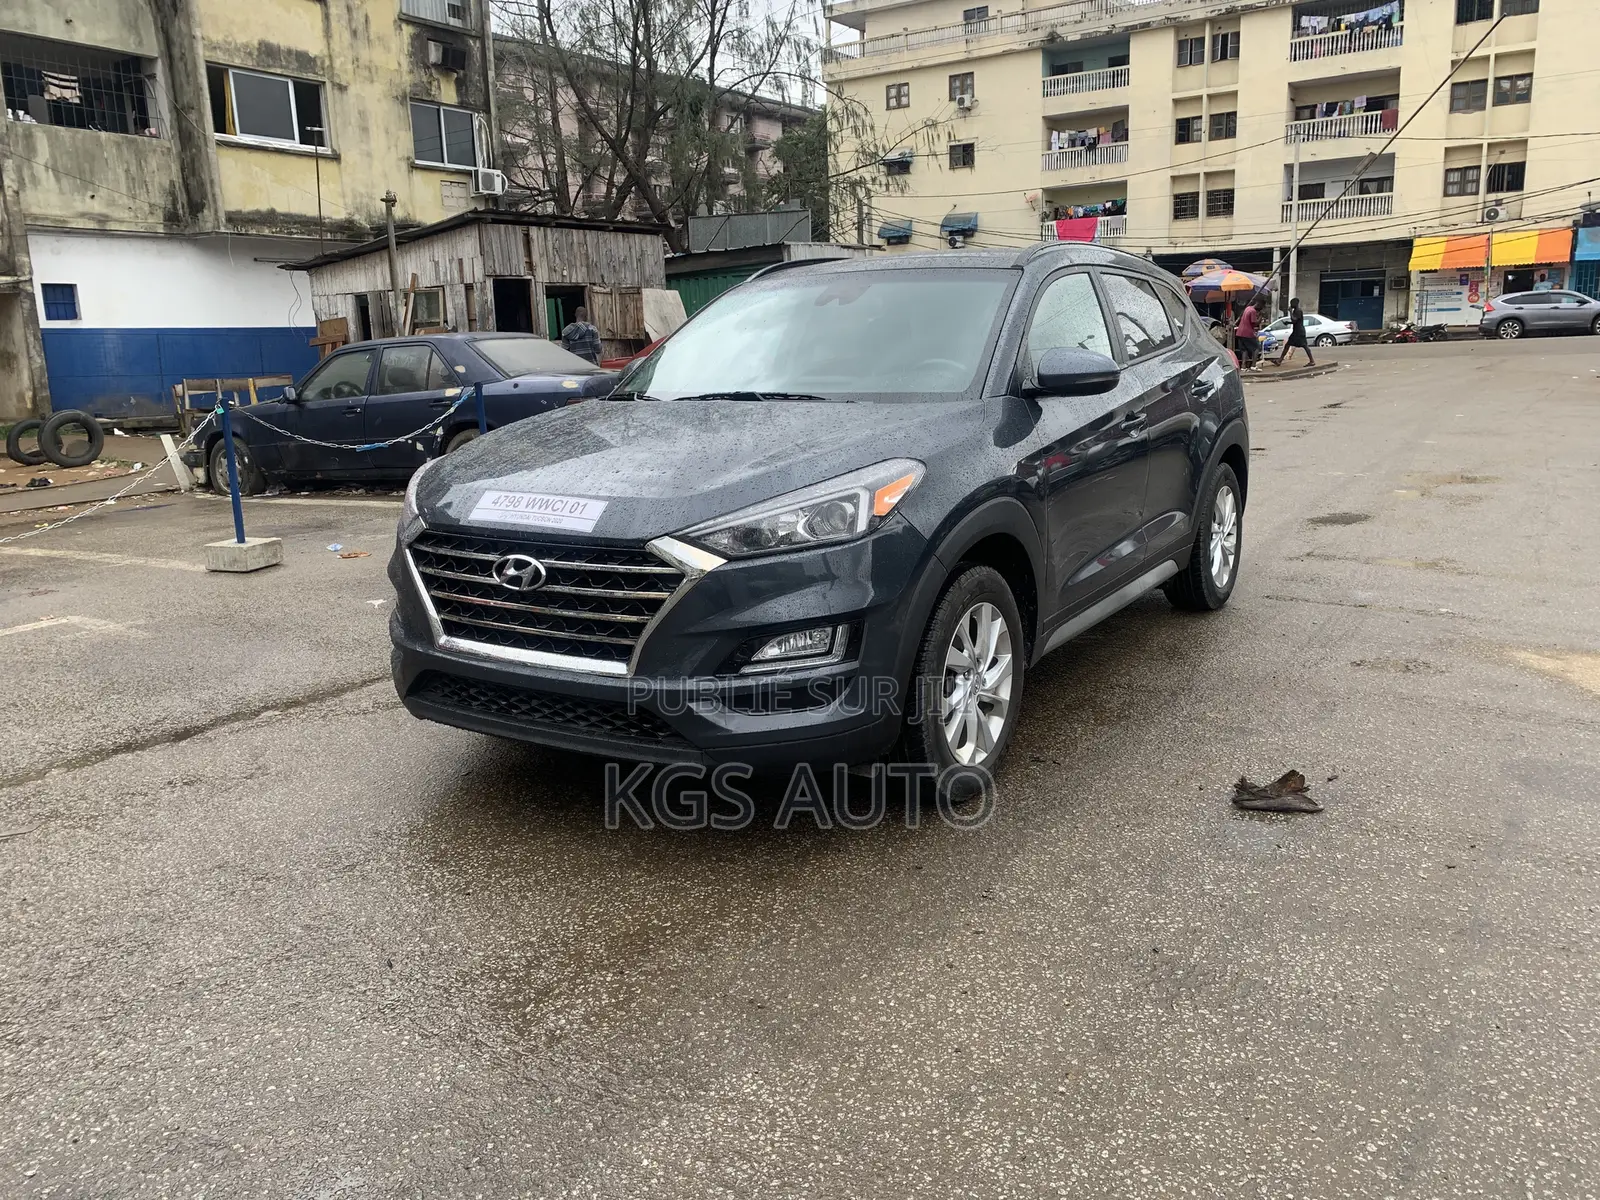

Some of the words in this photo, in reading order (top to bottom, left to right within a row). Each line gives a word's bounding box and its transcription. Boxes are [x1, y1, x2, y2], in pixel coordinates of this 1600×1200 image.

[492, 495, 524, 509] 4798
[525, 496, 569, 513] WWCI
[569, 501, 588, 515] 01
